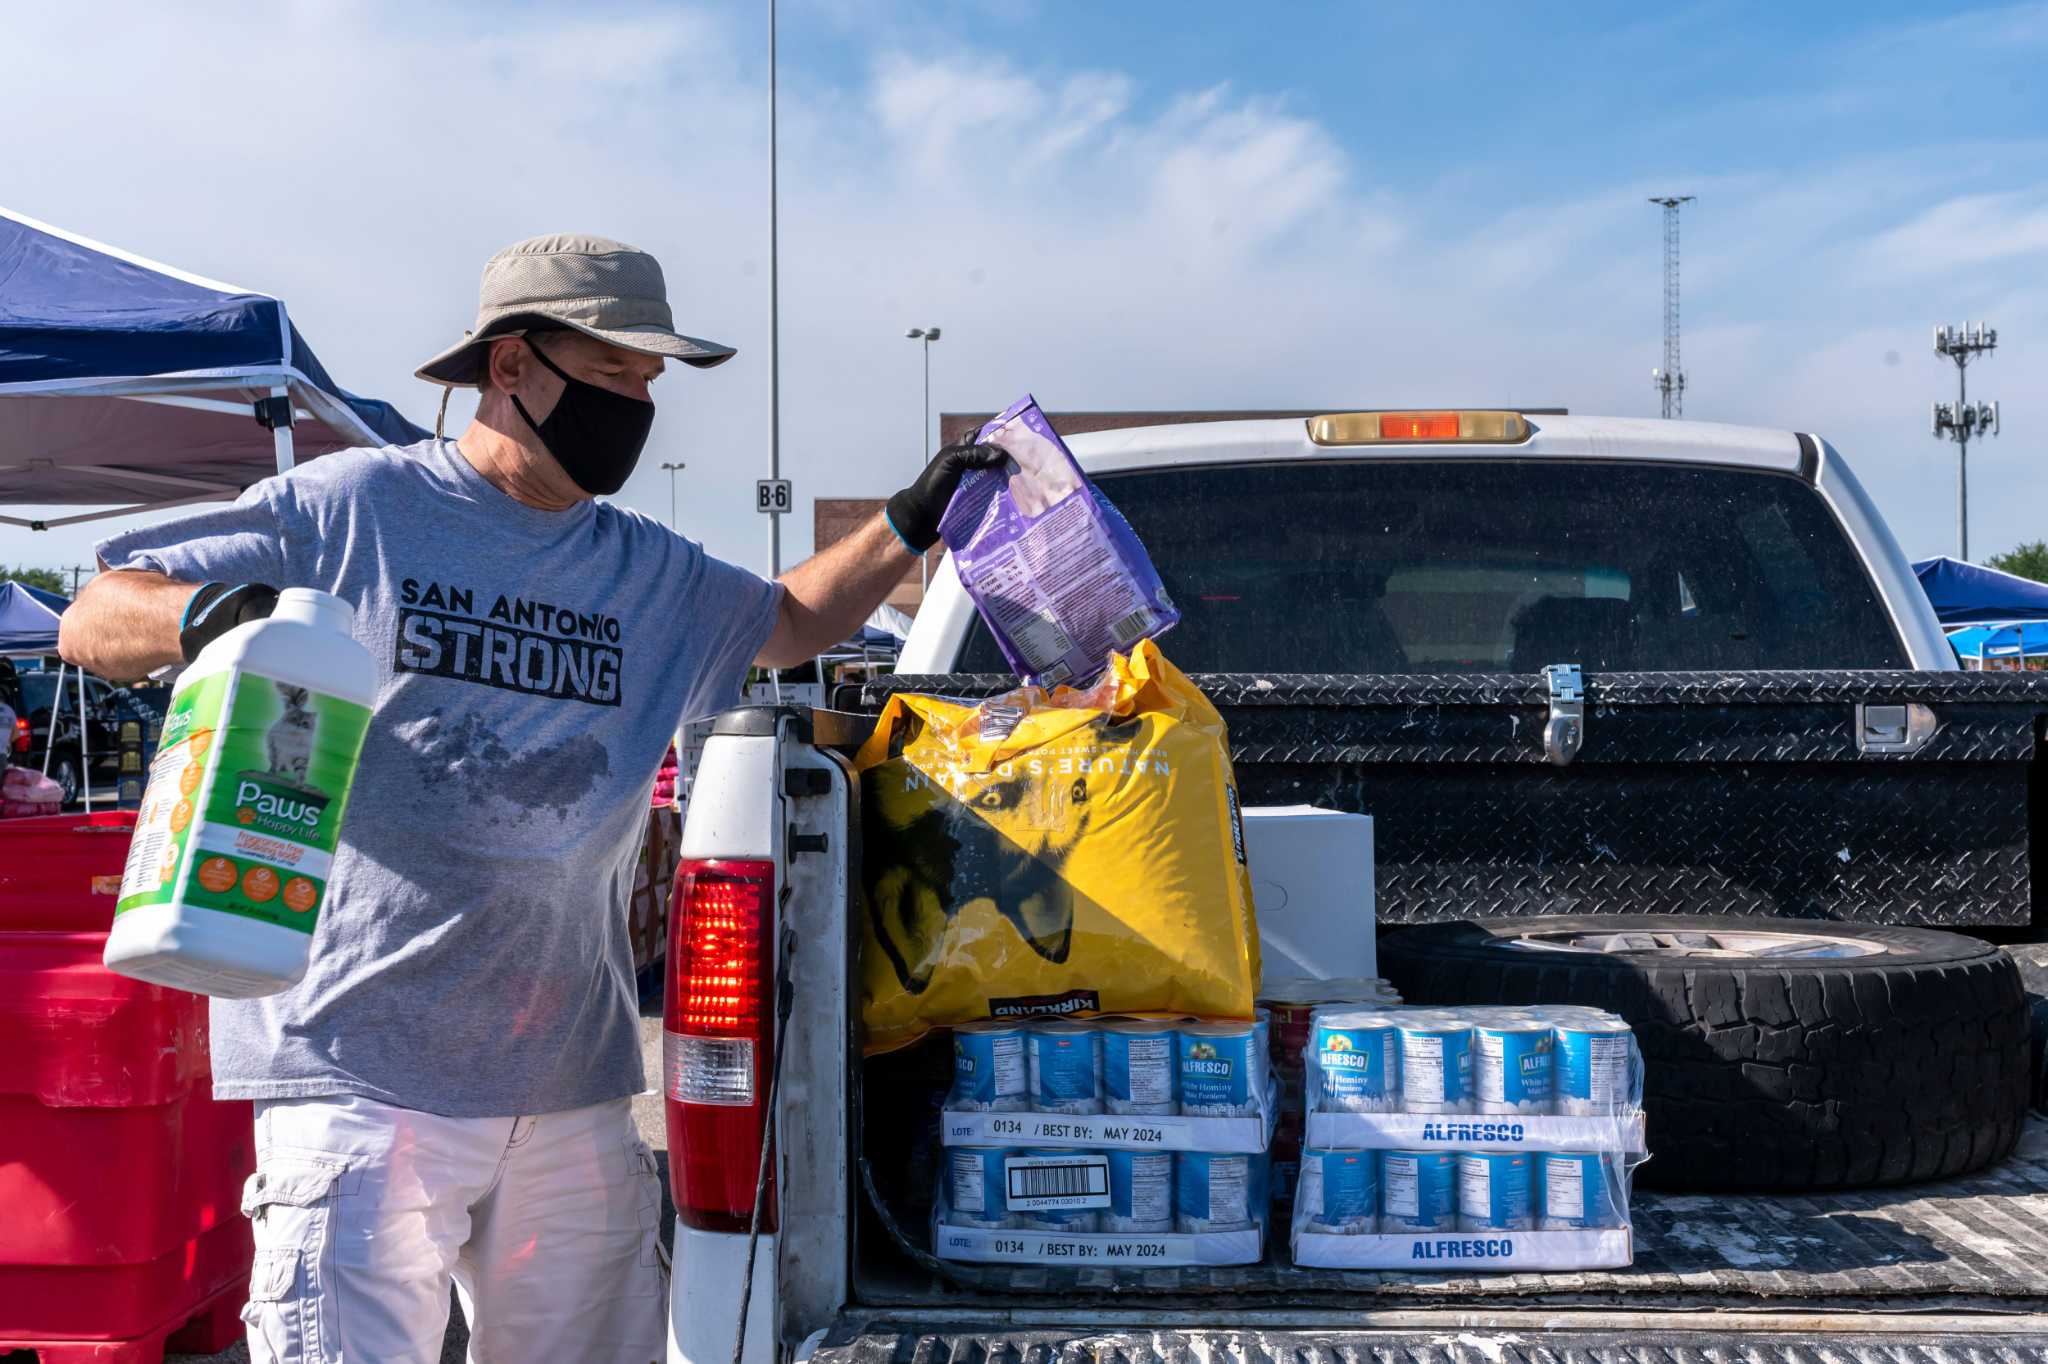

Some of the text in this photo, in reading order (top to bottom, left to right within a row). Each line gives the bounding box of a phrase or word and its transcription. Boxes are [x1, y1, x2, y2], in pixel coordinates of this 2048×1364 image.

[401, 578, 621, 643] SAN ANTONIO
[400, 614, 620, 701] STRONG
[1060, 746, 1098, 755] SWEET
[1028, 757, 1170, 776] NATURE'S
[235, 780, 321, 827] Paws
[257, 814, 320, 841] Happy Life
[994, 999, 1094, 1016] KIRKLAND
[1199, 1082, 1232, 1093] Hominy
[951, 1119, 1162, 1142] LOTE: 0134 / BEST BY: MAY 2024
[1422, 1123, 1524, 1141] ALFRESCO
[949, 1237, 1166, 1257] LOTE: 0134 / BEST BY: MAY 2024
[1411, 1239, 1513, 1258] ALFRESCO
